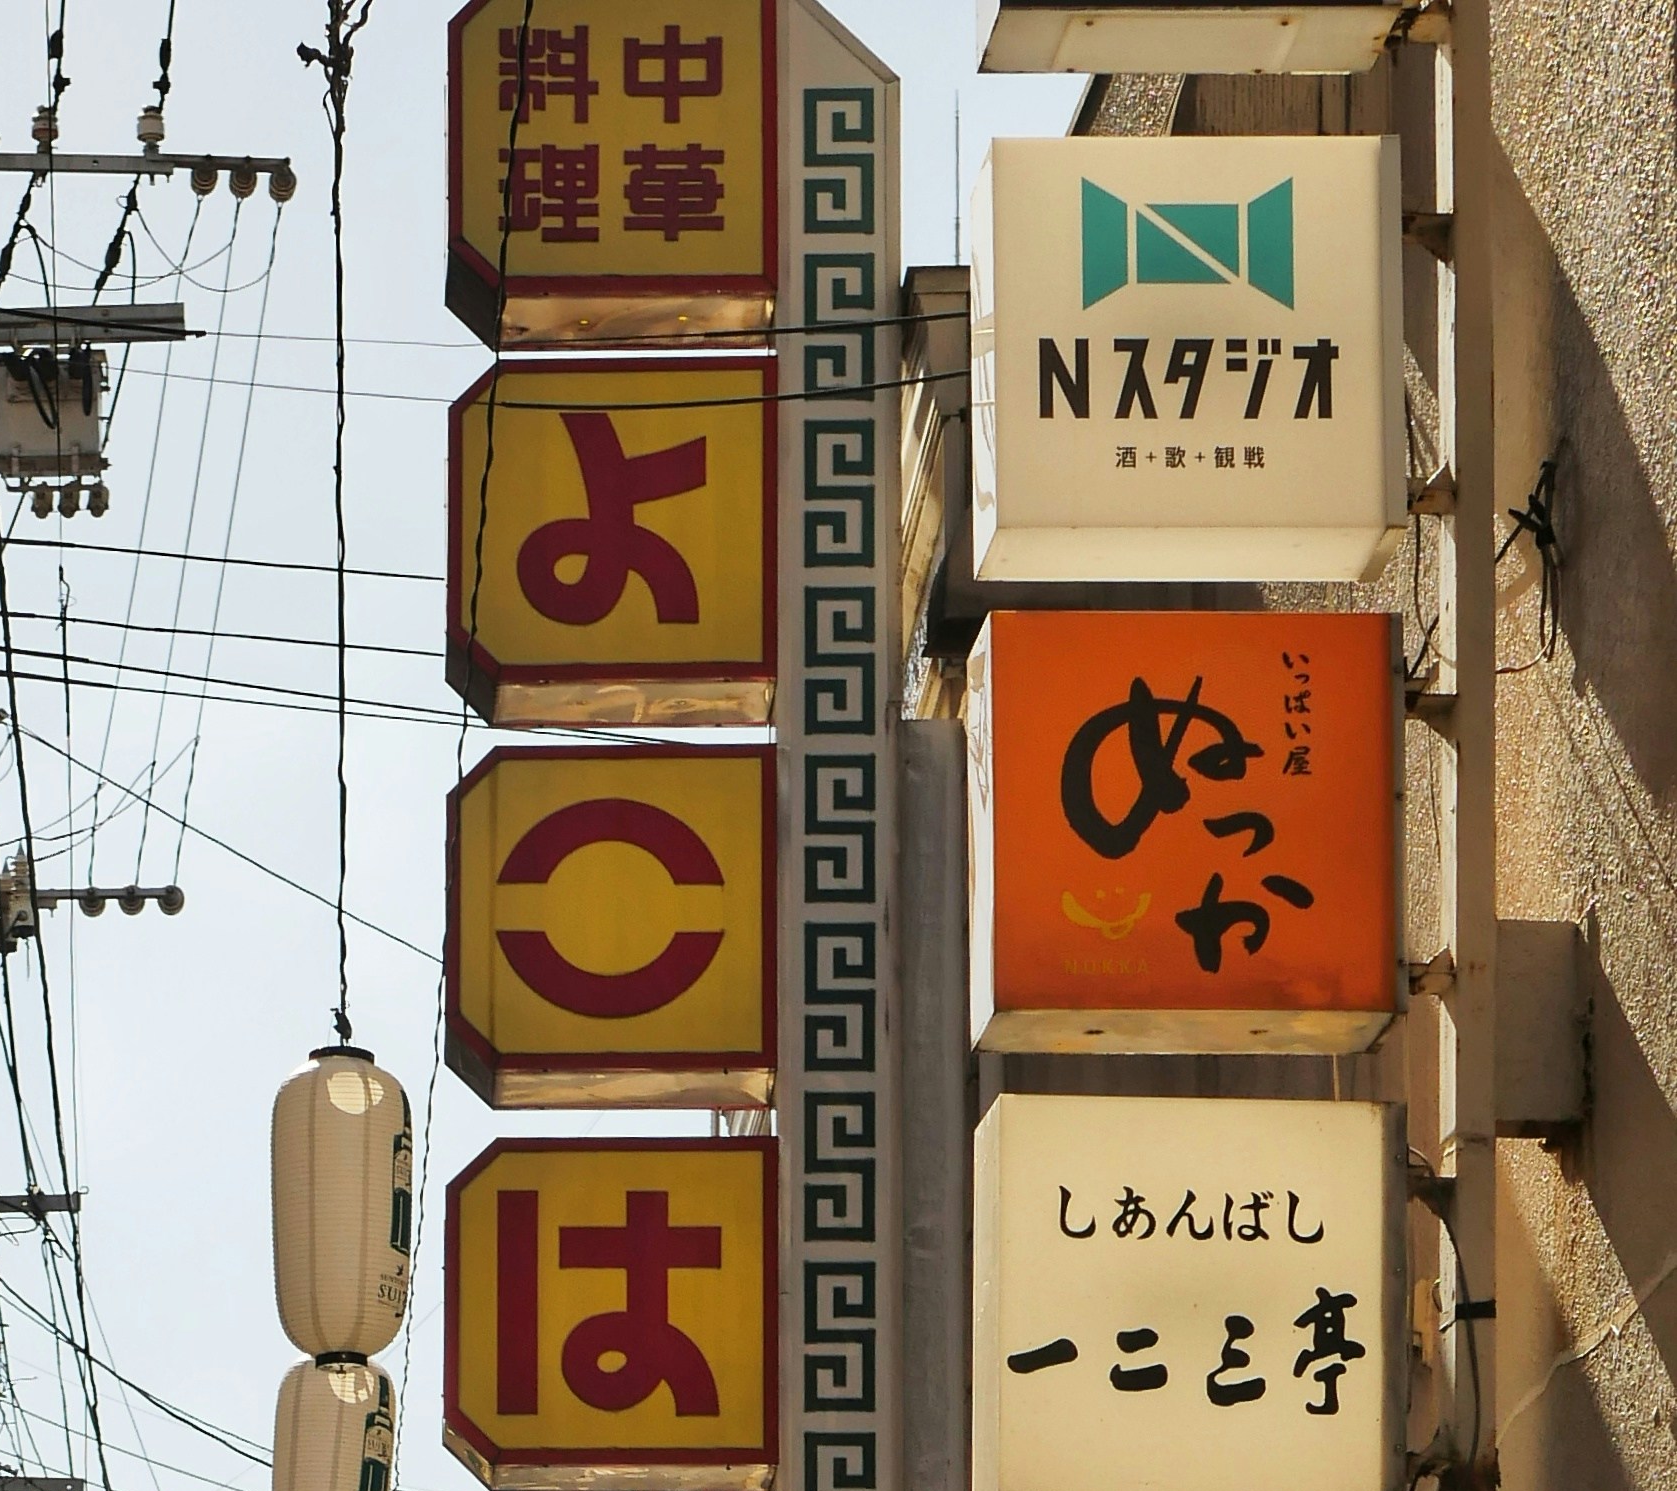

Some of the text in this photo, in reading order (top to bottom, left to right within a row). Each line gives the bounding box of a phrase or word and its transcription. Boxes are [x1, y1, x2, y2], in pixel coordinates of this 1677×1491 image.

[499, 24, 599, 242] 料理
[624, 24, 724, 241] 中華
[1282, 651, 1312, 776] いっぱい屋
[1060, 676, 1315, 974] ぬっか
[1064, 958, 1150, 975] NUKKA
[1059, 1186, 1324, 1244] しあんばし
[1007, 1287, 1365, 1415] 一二三亭
